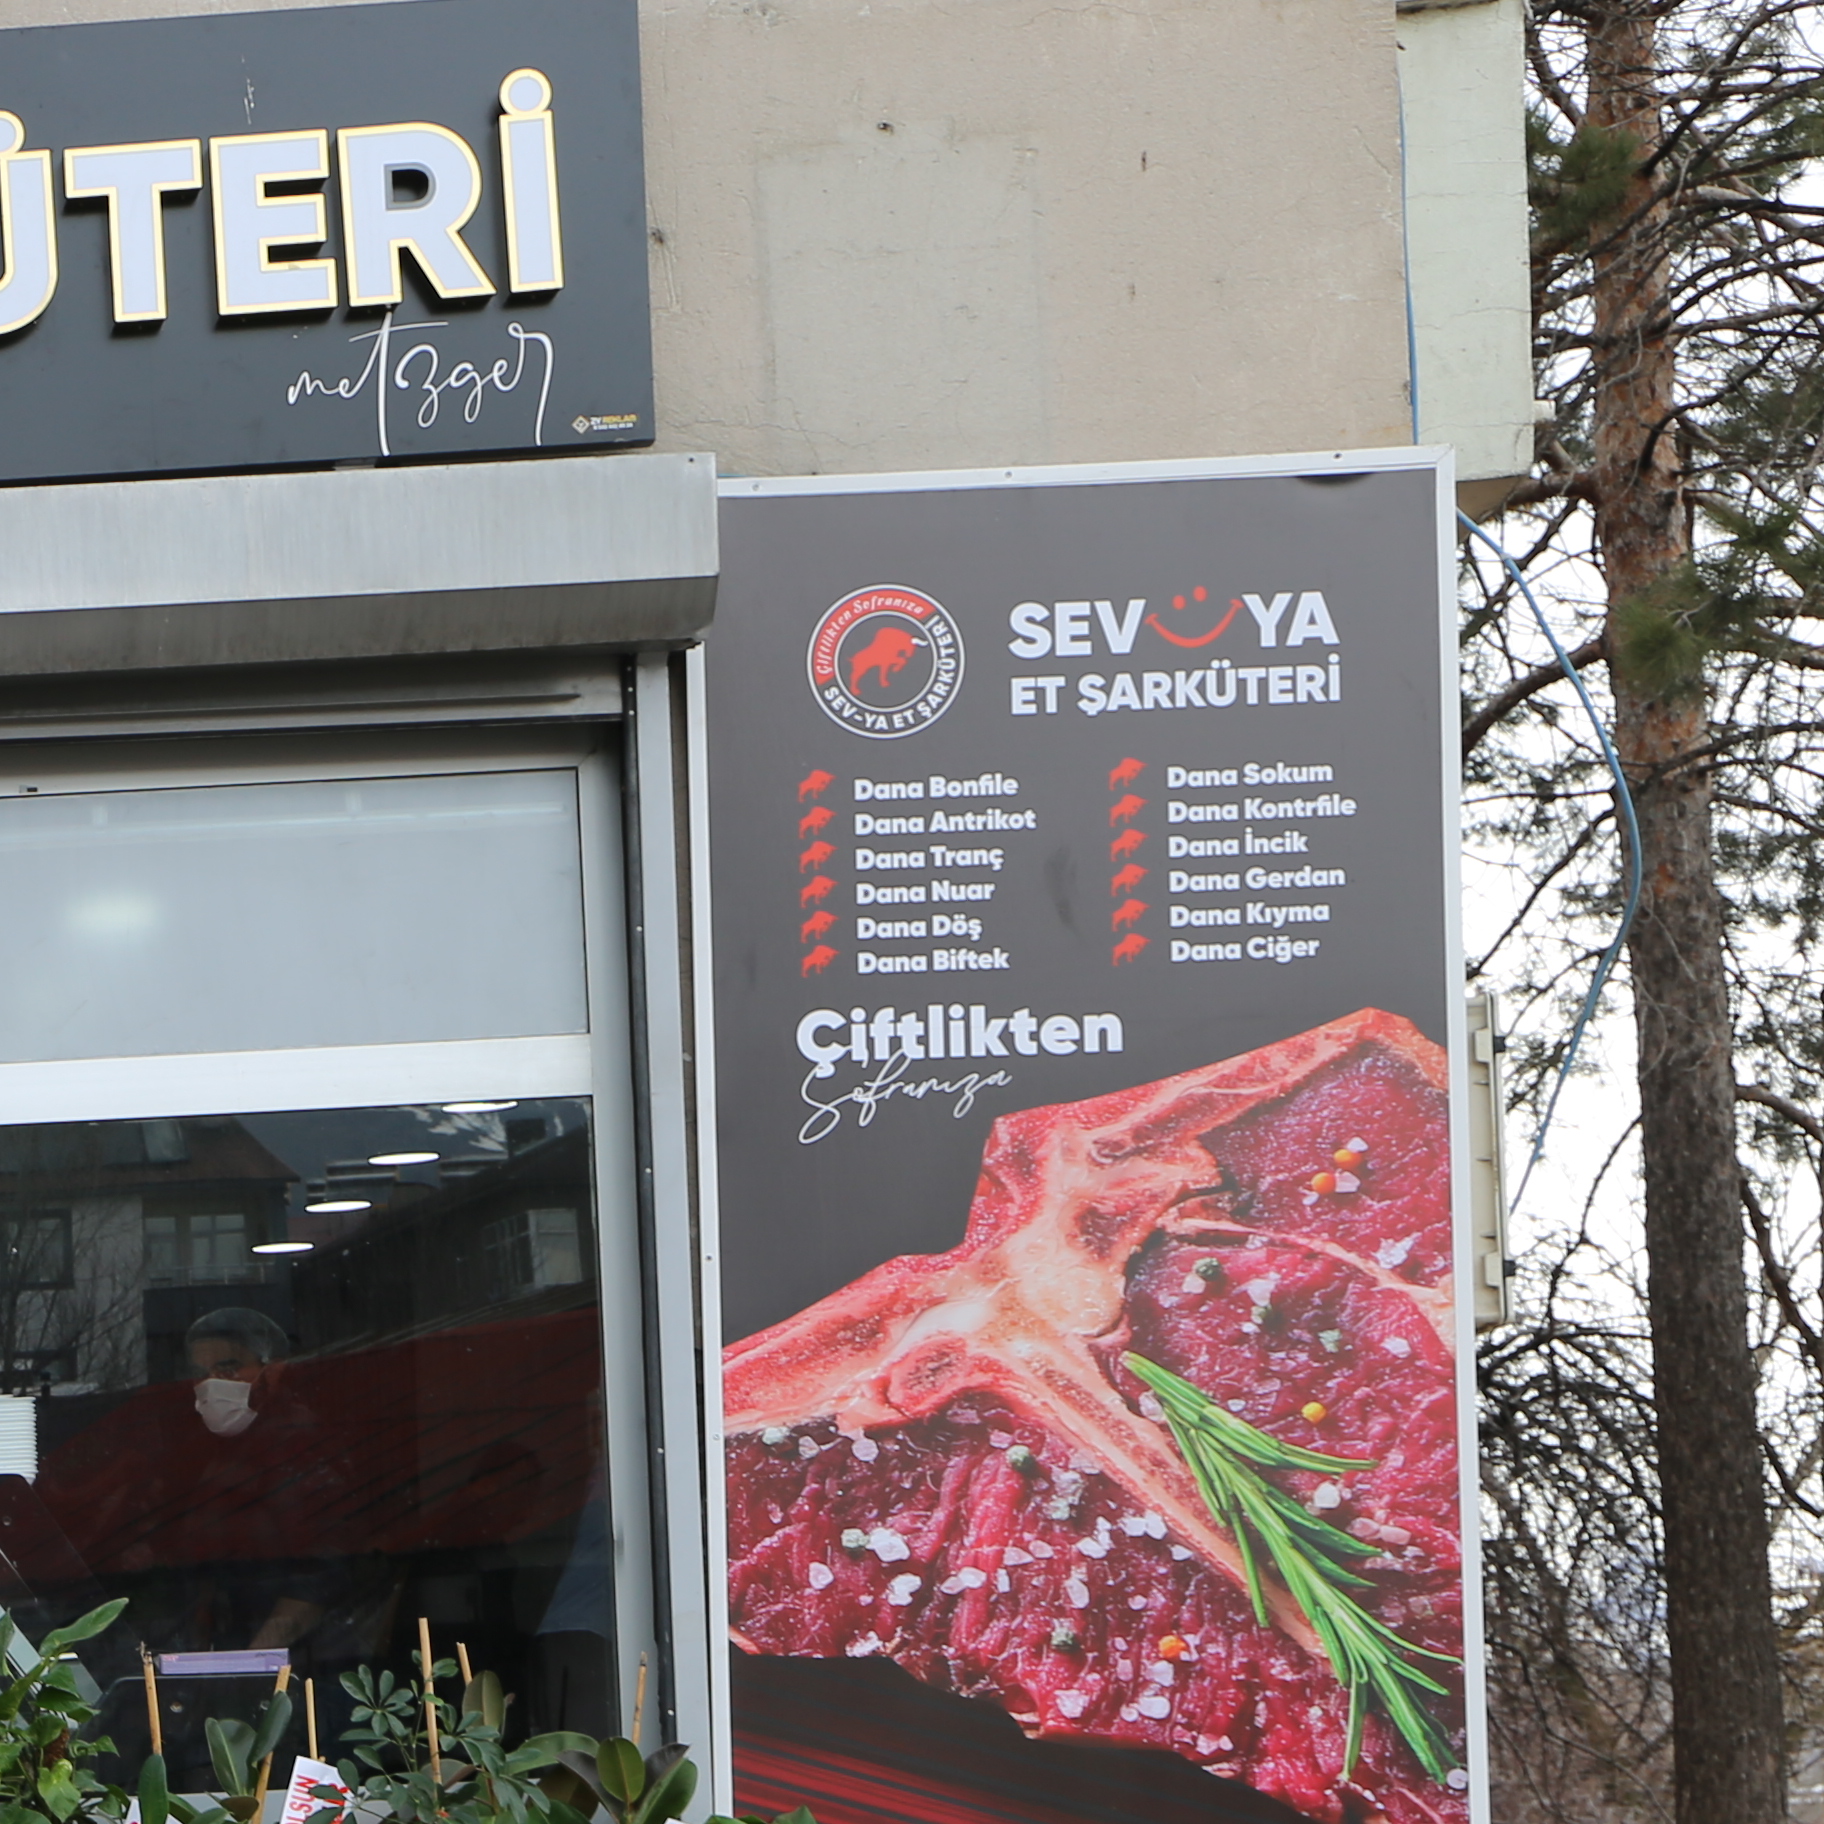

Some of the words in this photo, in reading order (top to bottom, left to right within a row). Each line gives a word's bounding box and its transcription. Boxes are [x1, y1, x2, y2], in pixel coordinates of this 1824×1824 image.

[286, 311, 553, 457] metzger
[1008, 598, 1147, 659] SEV
[1242, 591, 1341, 648] YA
[1009, 676, 1066, 715] ET
[1077, 654, 1342, 717] ŞARKÜTERİ
[892, 709, 915, 729] ET
[854, 778, 924, 801] Dana
[929, 773, 1020, 799] Bonfile
[1167, 766, 1238, 789] Dana
[1242, 761, 1333, 786] Sokum
[854, 812, 924, 836] Dana
[929, 808, 1037, 834] Antrikot
[1168, 801, 1239, 824] Dana
[1244, 794, 1357, 821] Kontrfile
[1168, 836, 1240, 859] Dana
[1244, 828, 1308, 855] İncik
[855, 848, 925, 871] Dana
[930, 844, 1004, 873] Tranç
[856, 883, 926, 905] Dana
[931, 880, 995, 903] Nuar
[1169, 870, 1240, 893] Dana
[1245, 865, 1346, 891] Gerdan
[856, 917, 926, 941] Dana
[932, 913, 983, 943] Döş
[1169, 905, 1241, 928] Dana
[1246, 902, 1331, 930] Kıyma
[857, 951, 927, 975] Dana
[932, 947, 1010, 972] Biftek
[1170, 940, 1242, 963] Dana
[1246, 935, 1320, 963] Ciğer
[796, 1004, 1124, 1079] Çiftlikten
